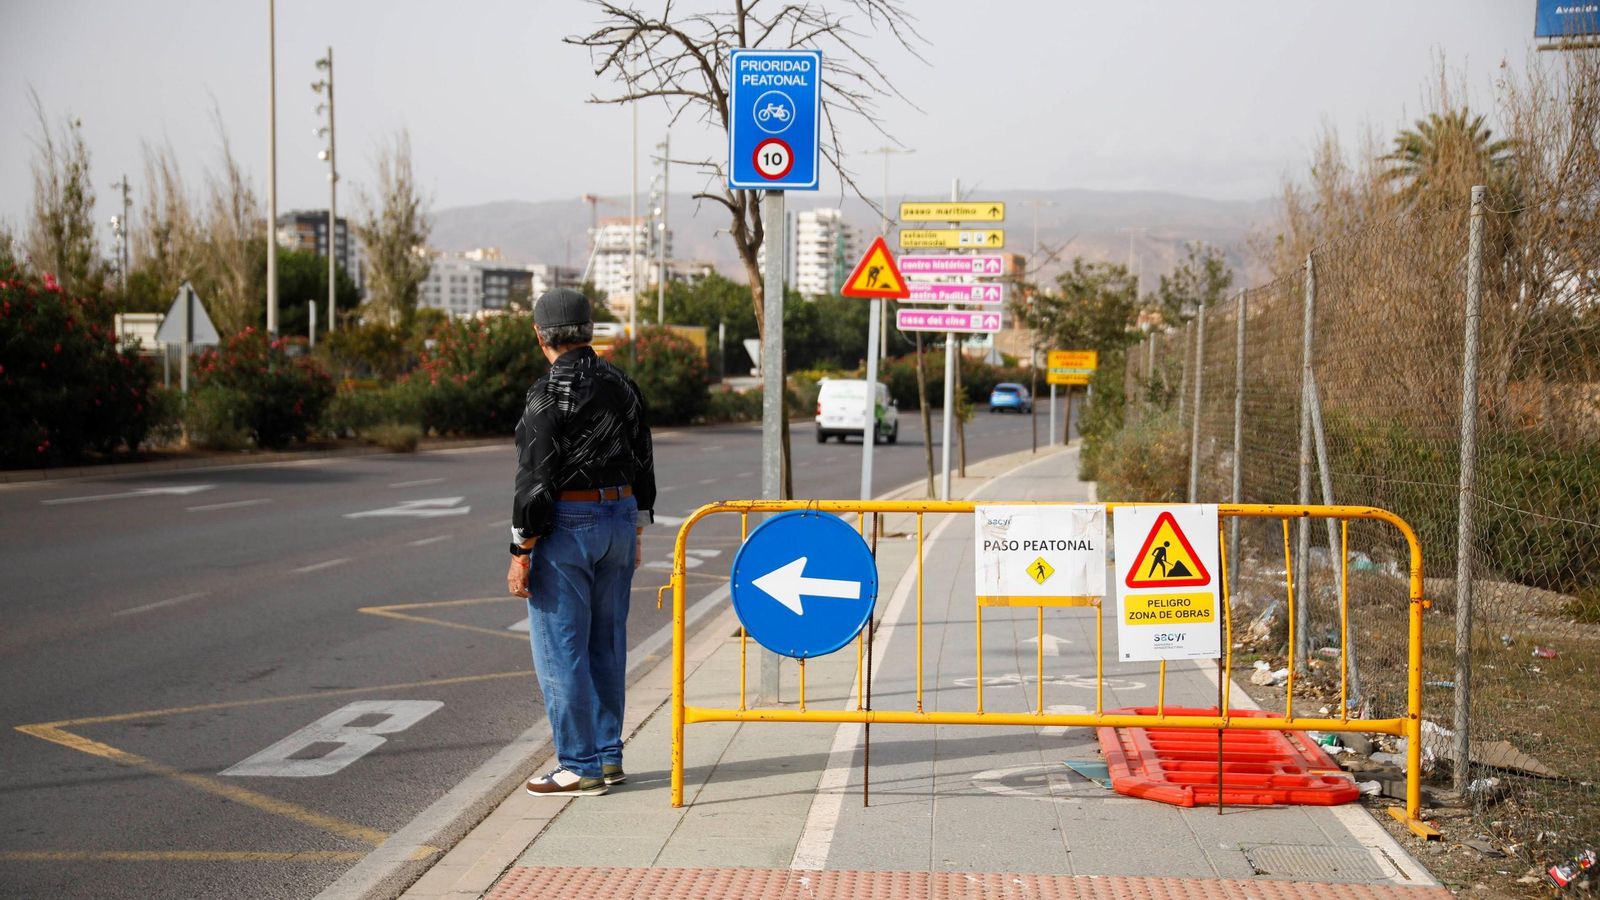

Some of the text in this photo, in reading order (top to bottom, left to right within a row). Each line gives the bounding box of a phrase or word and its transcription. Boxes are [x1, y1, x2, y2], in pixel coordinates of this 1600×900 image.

[1555, 5, 1598, 14] Avenida
[740, 60, 810, 72] PRIORIDAD
[742, 75, 808, 86] PEATONAL
[763, 153, 782, 166] 10
[903, 208, 931, 217] paseo
[902, 261, 931, 269] centro
[901, 315, 966, 325] casa del cine
[987, 516, 1012, 527] sacyr
[984, 540, 1094, 551] PASO PEATONAL
[1147, 598, 1191, 608] PELIGRO
[1129, 609, 1210, 620] ZONA DE OBRAS
[1154, 633, 1186, 642] sacyr
[216, 700, 445, 777] B
